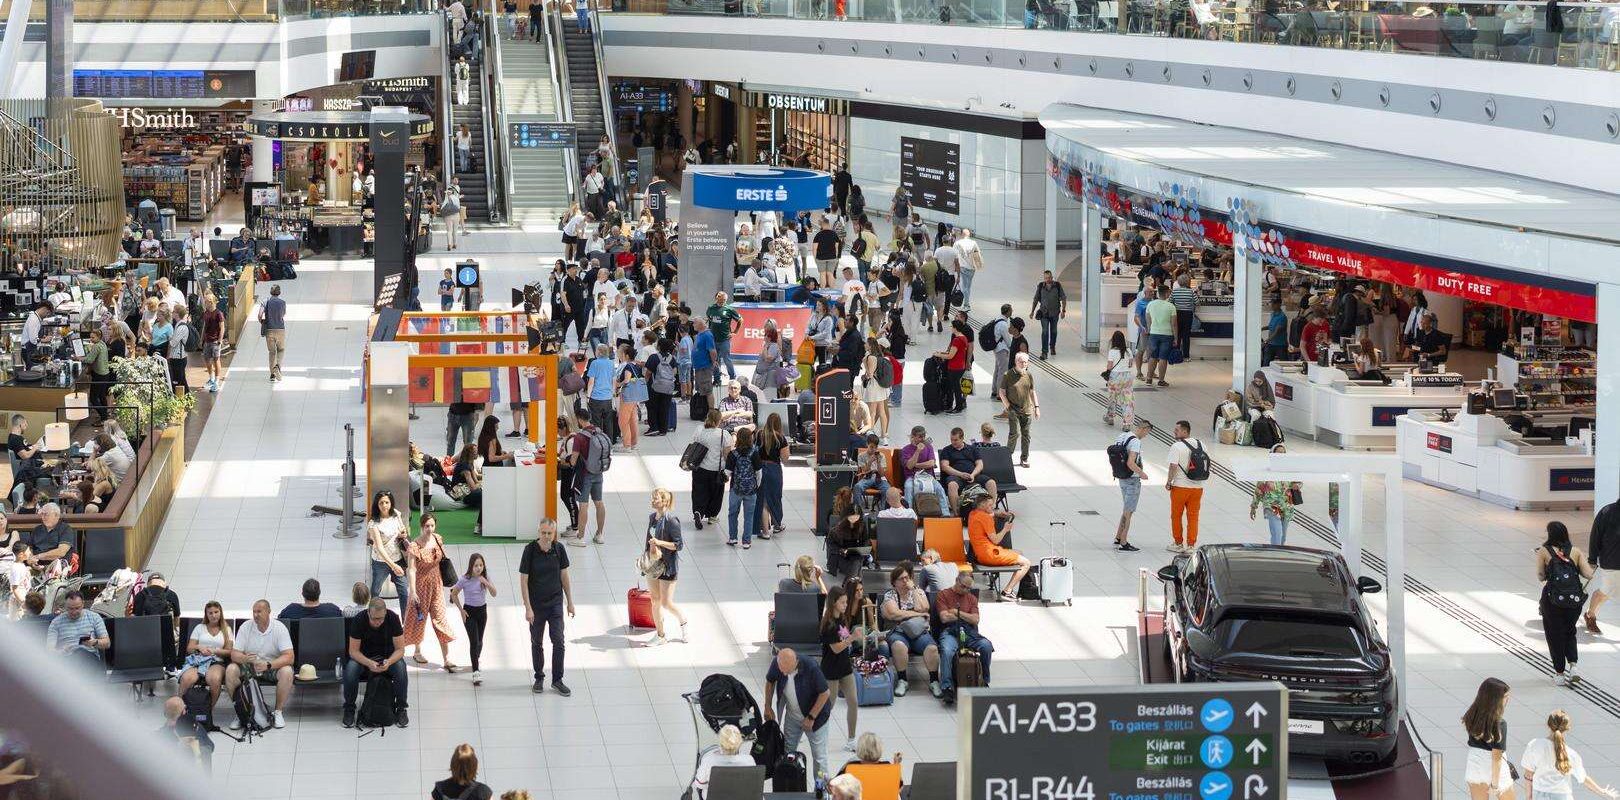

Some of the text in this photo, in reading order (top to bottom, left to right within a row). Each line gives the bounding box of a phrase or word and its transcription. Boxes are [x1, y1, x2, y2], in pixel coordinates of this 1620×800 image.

[323, 98, 352, 111] KASSZA
[769, 95, 825, 112] OBSENTUM
[103, 107, 195, 128] HSmith
[288, 125, 364, 138] CSOKOLÁ
[736, 189, 774, 201] ERSTE
[1307, 250, 1362, 270] TRAVEL VALUE
[1437, 276, 1492, 296] DUTY FREE
[1262, 674, 1326, 683] PORSCHE
[979, 701, 1194, 734] A1-A33 Beszállás
[1109, 720, 1124, 731] To
[1126, 721, 1159, 733] gates
[1146, 739, 1185, 752] Kijárat
[1146, 754, 1193, 765] Exit 出口
[985, 776, 1193, 800] B1-B44 Beszállás
[1108, 792, 1121, 800] To
